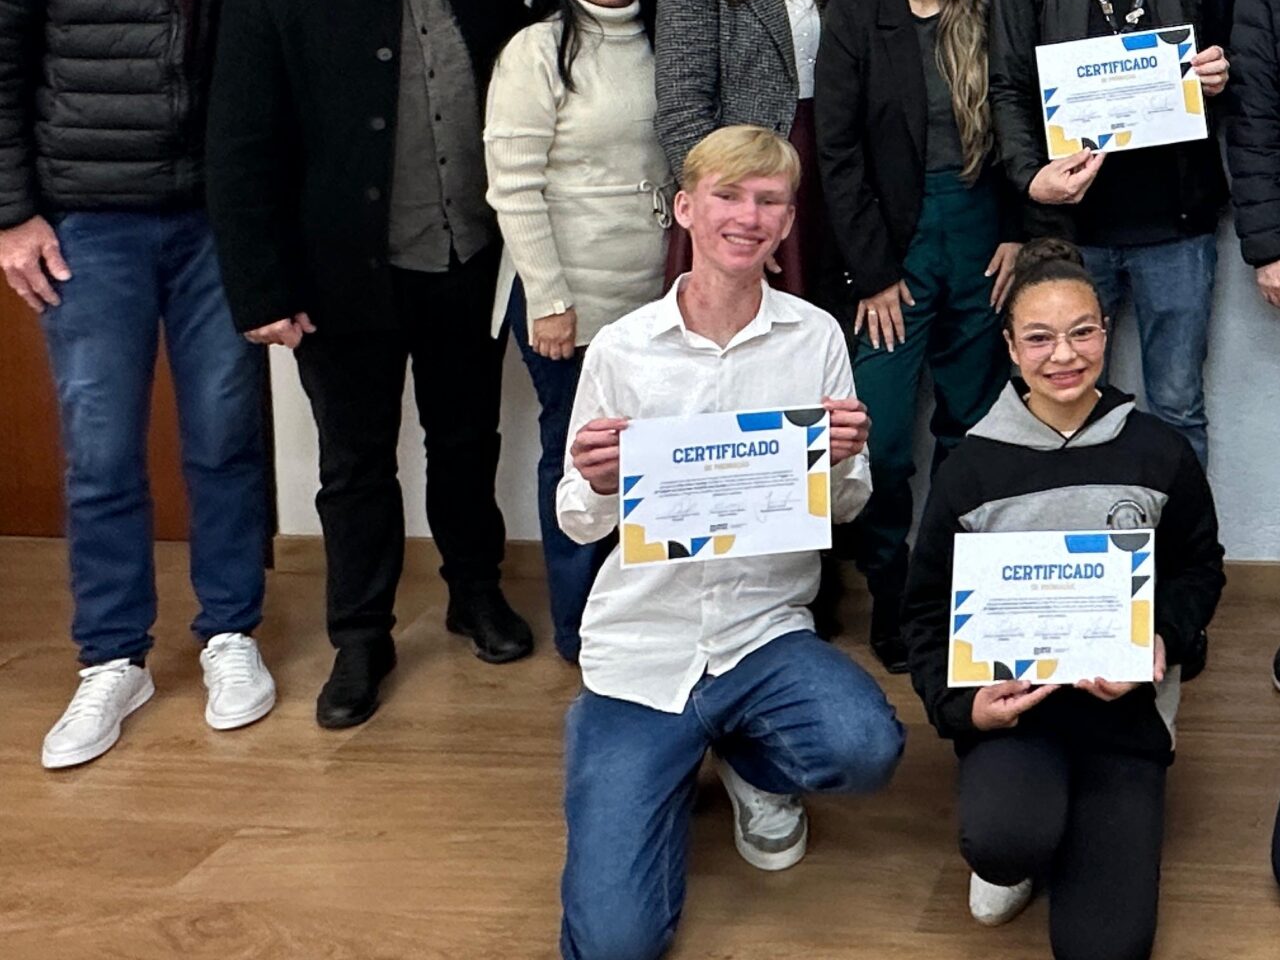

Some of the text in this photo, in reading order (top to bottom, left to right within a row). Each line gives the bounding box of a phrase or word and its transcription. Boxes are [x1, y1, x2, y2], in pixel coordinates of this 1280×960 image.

[1076, 55, 1158, 78] CERTIFICADO
[672, 439, 780, 464] CERTIFICADO
[1001, 562, 1105, 581] CERTIFICADO
